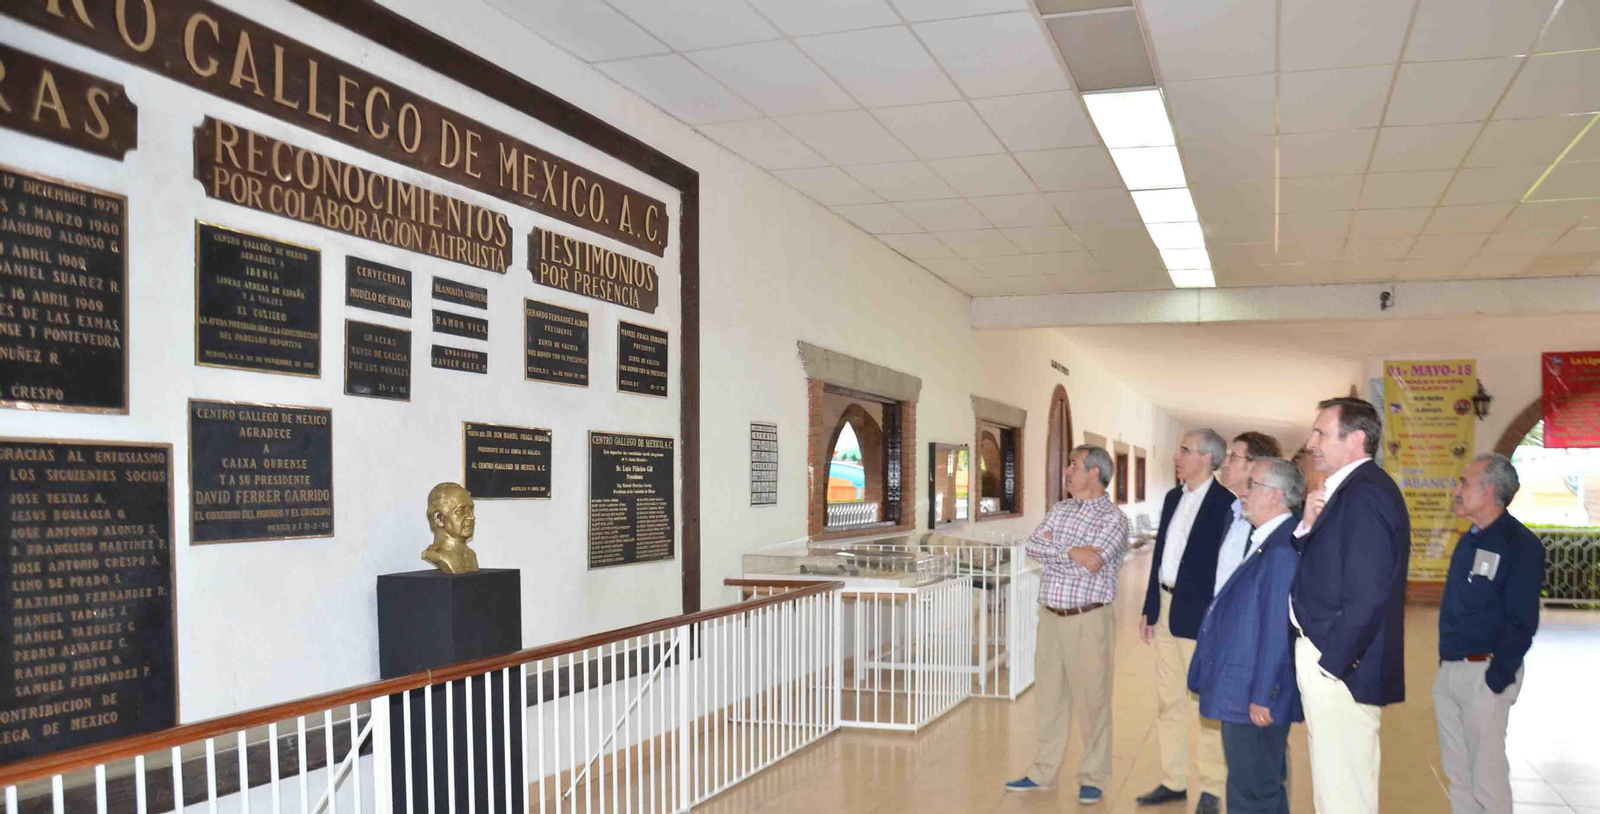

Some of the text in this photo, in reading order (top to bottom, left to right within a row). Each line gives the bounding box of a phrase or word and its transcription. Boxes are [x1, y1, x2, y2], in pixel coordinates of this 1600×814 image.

[184, 13, 422, 154] GALLEGO
[439, 118, 482, 179] DE
[498, 141, 609, 226] MEXICO.
[619, 194, 641, 238] A.
[645, 203, 662, 245] C.
[214, 120, 508, 248] RECONOCIMIENTOS
[4, 174, 119, 215] 17 DICIEMBRE 1979
[34, 206, 83, 229] MARZO
[213, 166, 506, 274] POR COLABORACION ALTRUISTA
[60, 230, 105, 250] ALONSO
[12, 244, 52, 264] ABRIL
[539, 228, 655, 291] TESTIMONIOS
[53, 270, 104, 290] SUAREZ
[245, 266, 279, 281] IBERIA
[356, 265, 406, 287] CERVECERIA
[540, 262, 640, 309] POR PRESENCIA
[12, 287, 26, 300] 16
[33, 290, 69, 308] ABRIL
[350, 287, 411, 309] MODELO DE MEXICO
[22, 306, 39, 321] DE
[47, 310, 70, 325] LAS
[237, 305, 287, 322] EL COLISEO
[526, 308, 548, 320] GERARDO
[435, 316, 464, 329] RAMON
[544, 324, 572, 336] PRESIDENTE
[43, 326, 121, 349] PONTEVEDRA
[363, 333, 396, 347] GRACIAS
[373, 350, 382, 358] DE
[384, 350, 408, 362] GALICIA
[433, 358, 459, 368] JAVIER
[349, 360, 363, 370] POR
[365, 363, 378, 373] LOS
[11, 385, 64, 401] CRESPO
[197, 408, 327, 426] CENTRO GALLEGO DE MEXICO
[239, 426, 292, 439] AGRADECE
[262, 444, 270, 454] A
[592, 435, 645, 448] CENTRO GALLEGO DE
[67, 450, 84, 462] AL
[95, 451, 166, 464] ENTUSIASMO
[222, 458, 308, 470] CAIXA OURENSE
[10, 468, 166, 483] LOS SIGUIENTES SOCIOS
[228, 475, 311, 485] A SU PRESIDENTE
[11, 492, 91, 505] JOSE TESTAS
[195, 489, 330, 504] DAVID FERRER GARRIDO
[11, 510, 46, 521] JESUS
[11, 525, 145, 540] JOSE ANTONIO ALONSO
[26, 539, 154, 555] FRANCISCO MARTINEZ
[12, 556, 146, 574] JOSE ANTONIO CRESPO
[12, 574, 109, 592] LINO DE PRADO
[13, 587, 153, 609] MAXIMINO FERNANDEZ
[13, 611, 64, 627] MANUEL
[13, 629, 64, 645] MANUEL
[14, 639, 113, 662] PEDRO ALVAREZ
[14, 657, 107, 680] RAMIRO JUSTO
[14, 668, 139, 697] SAMUEL FERNANDEZ
[102, 693, 118, 706] DE
[43, 722, 60, 737] DE
[71, 711, 118, 731] MEXICO
